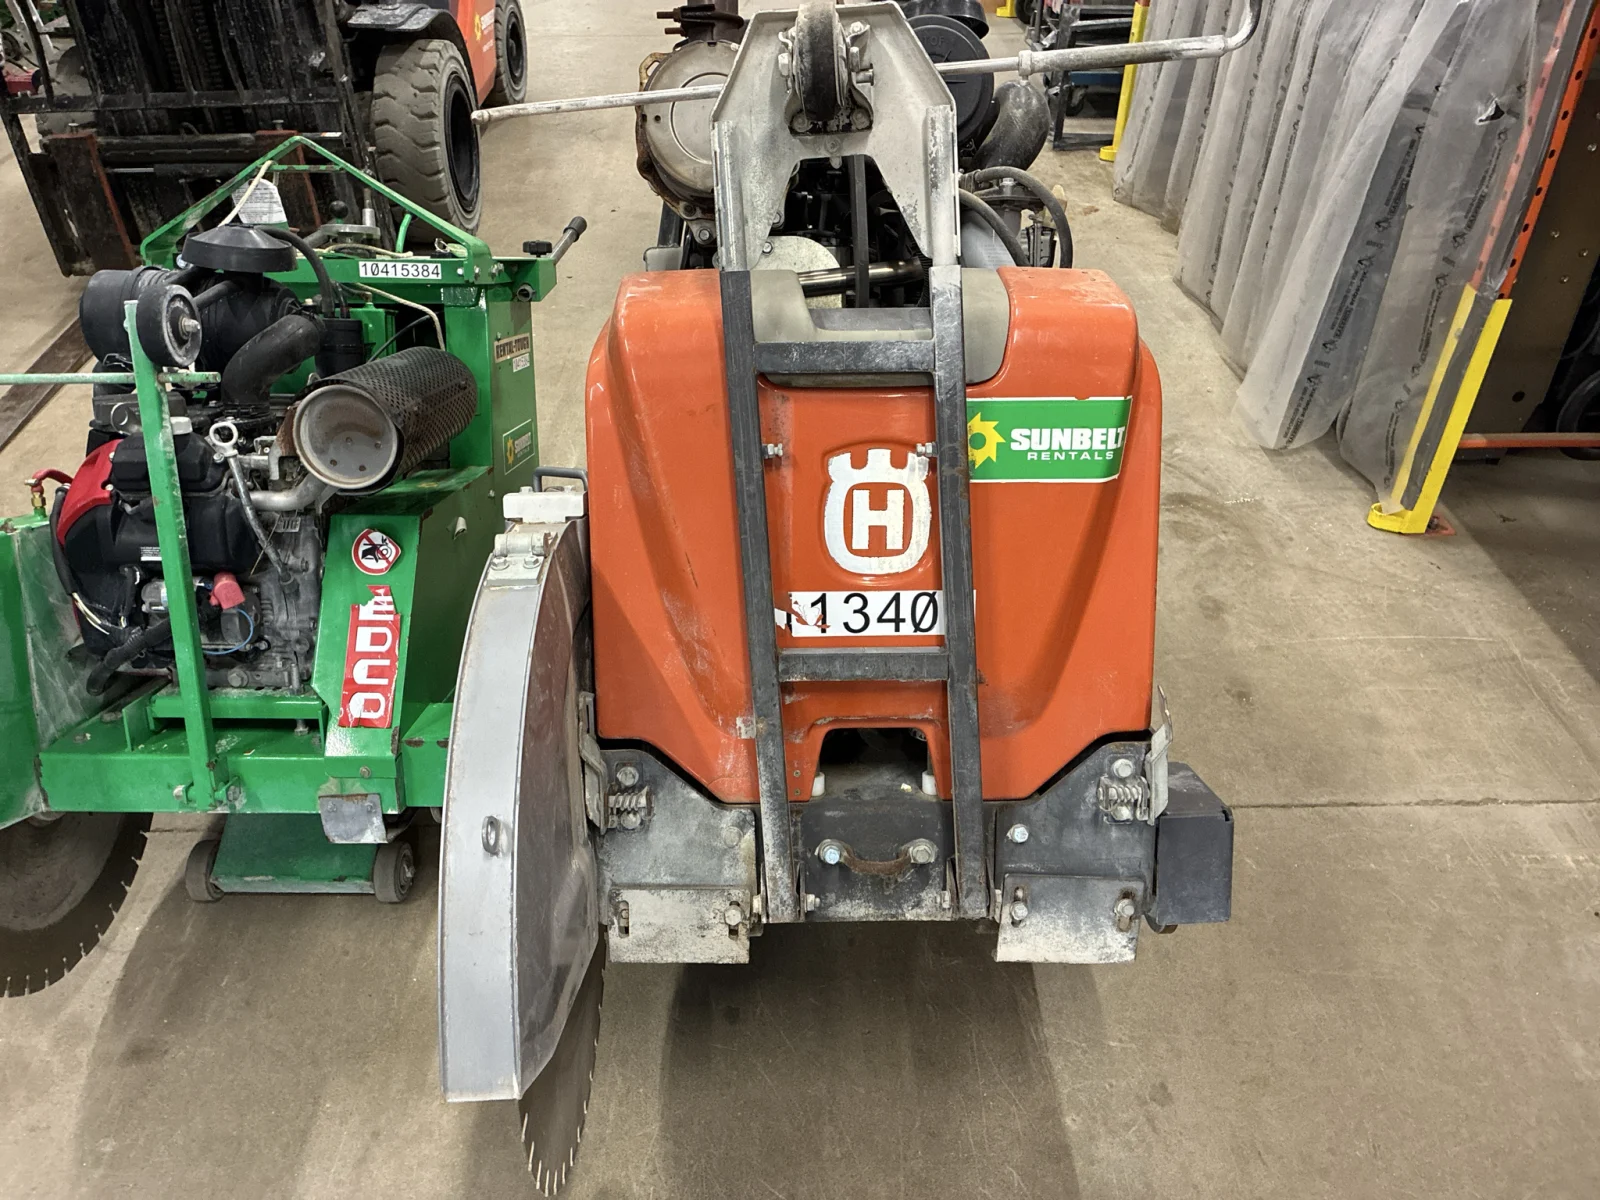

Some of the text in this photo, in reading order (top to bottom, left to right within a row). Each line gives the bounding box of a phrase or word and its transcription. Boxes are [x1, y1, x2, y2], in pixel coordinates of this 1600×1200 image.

[361, 263, 440, 278] 10415384
[1010, 426, 1125, 450] SUNBELT
[1027, 451, 1114, 461] RENTALS
[350, 596, 394, 719] EDCO
